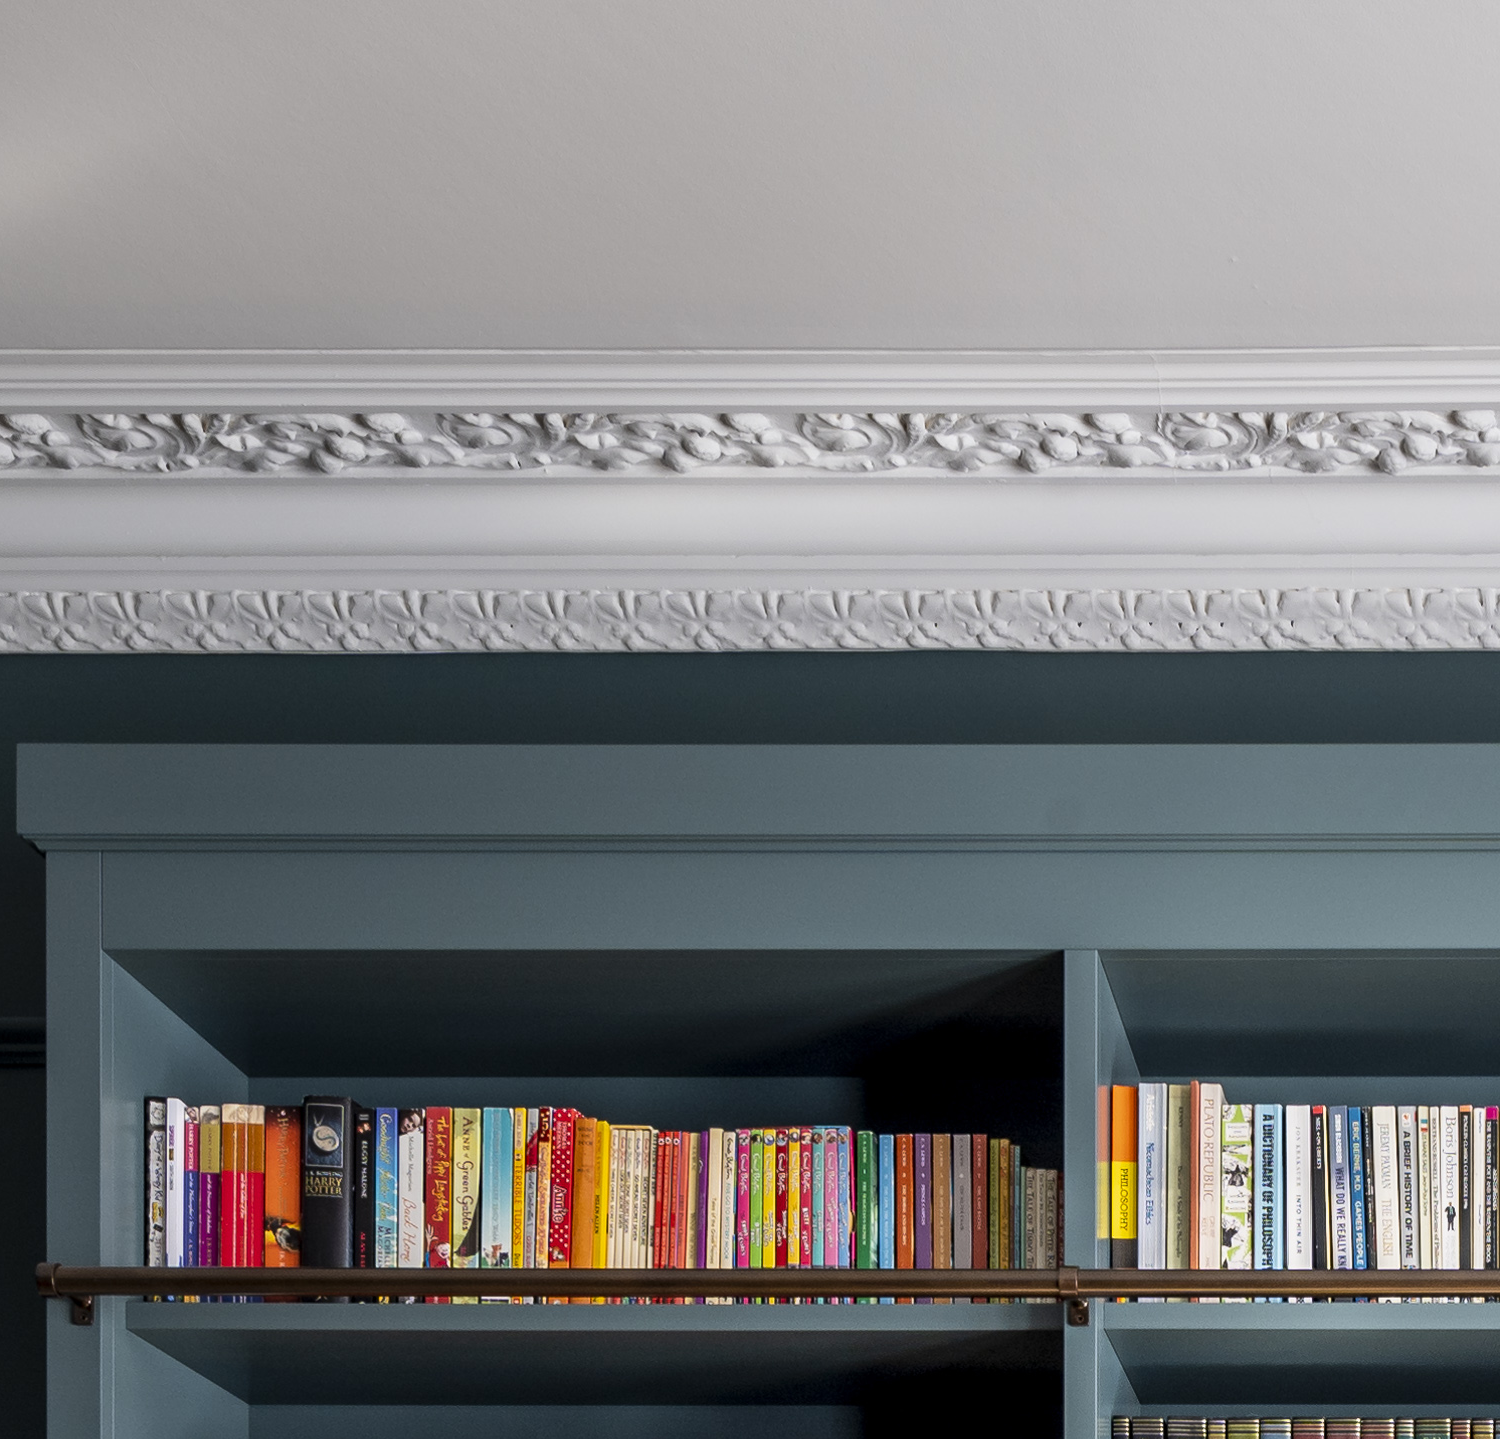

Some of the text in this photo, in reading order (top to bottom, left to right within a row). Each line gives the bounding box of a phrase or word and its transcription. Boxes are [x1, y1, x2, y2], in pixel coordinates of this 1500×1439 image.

[462, 1117, 473, 1150] ANNE
[1443, 1117, 1456, 1198] Boris Johnson
[305, 1176, 343, 1187] HARRY
[305, 1187, 343, 1196] POTTER
[456, 1161, 473, 1193] Green
[1403, 1131, 1413, 1258] A BRIEF HISTORY OF TIME
[456, 1195, 474, 1231] Gables
[552, 1185, 567, 1223] Annie
[1120, 1168, 1129, 1231] PHILOSOPHY
[402, 1198, 417, 1263] Back Home
